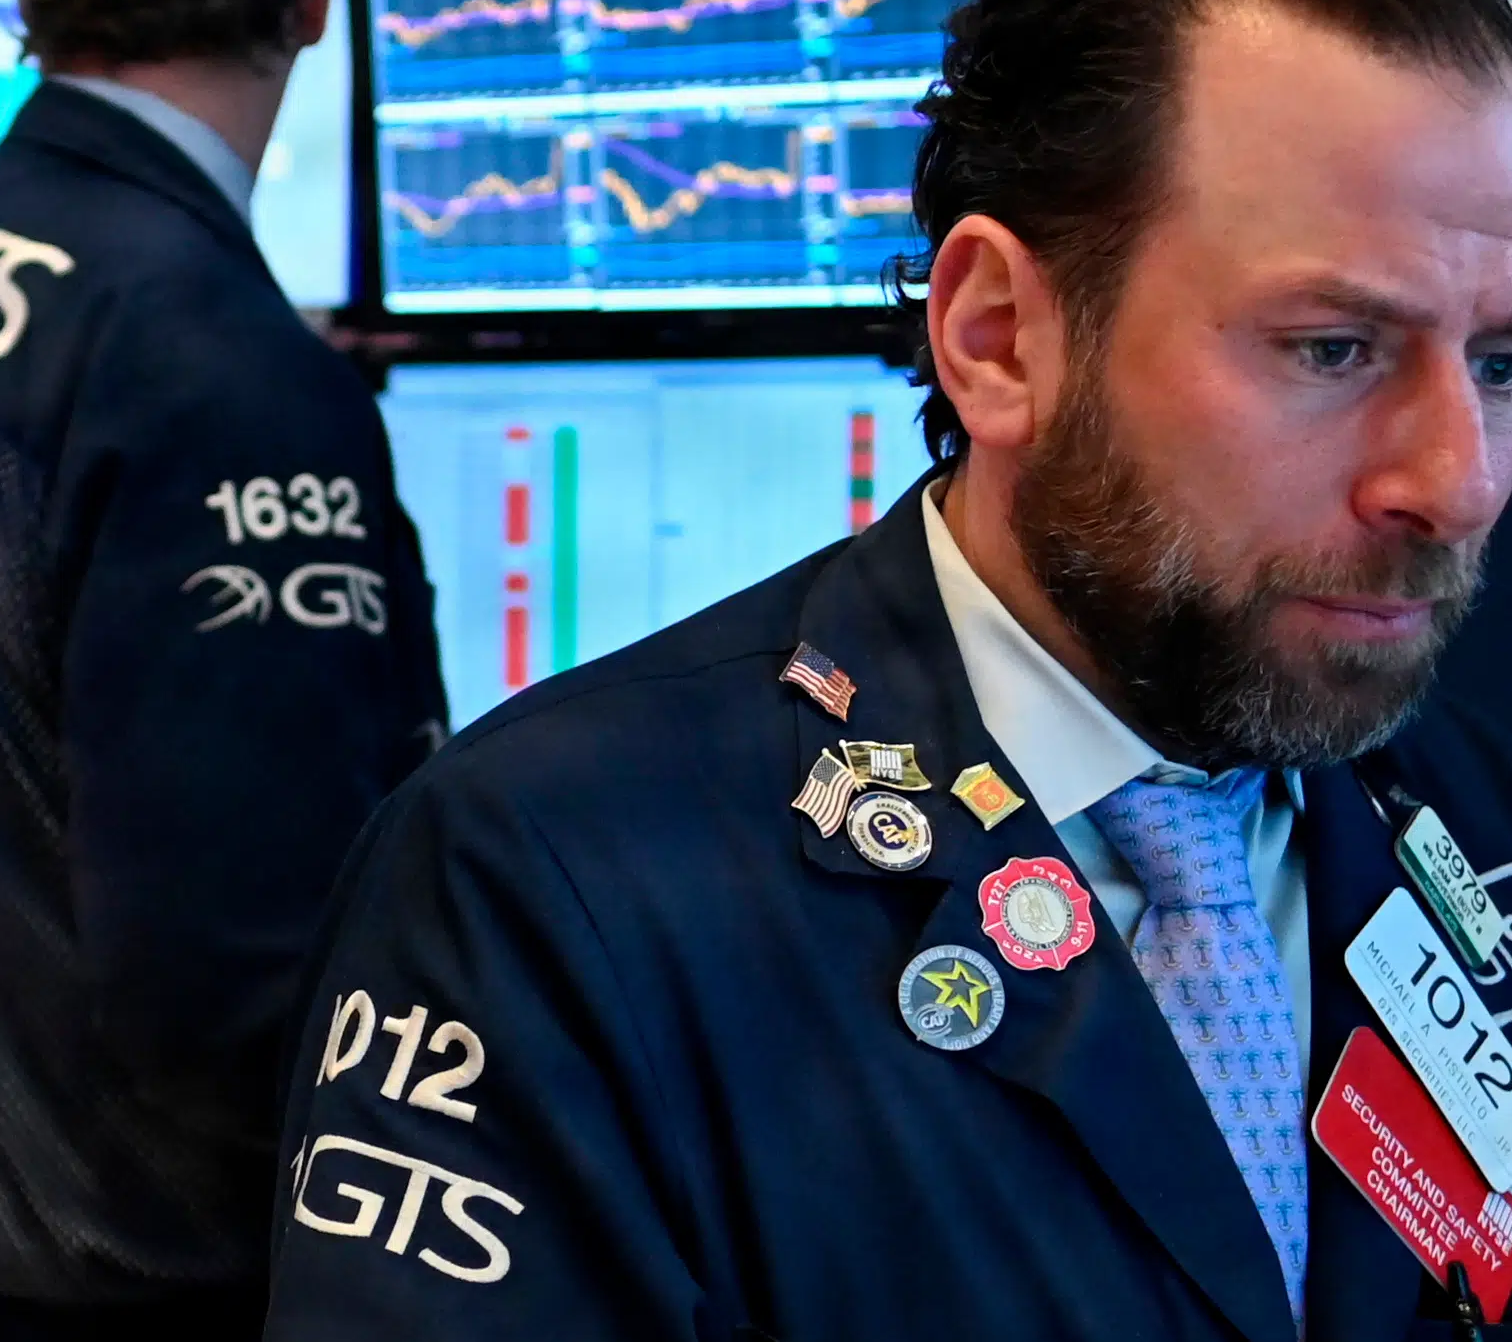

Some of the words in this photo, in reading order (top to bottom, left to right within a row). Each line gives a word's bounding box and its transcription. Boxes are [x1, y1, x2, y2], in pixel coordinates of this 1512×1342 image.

[205, 473, 367, 544] 1632
[279, 562, 388, 635] GTS
[869, 767, 904, 782] NYSE
[872, 813, 905, 845] CAF
[987, 880, 1007, 906] T2T
[1431, 831, 1491, 918] 3979
[1002, 939, 1045, 965] FDNY
[1070, 920, 1090, 947] 9-11
[963, 948, 1002, 986] HEROES
[986, 988, 1004, 1027] HEART
[1364, 938, 1419, 1017] MICHAEL
[1419, 1019, 1432, 1038] A
[293, 1132, 525, 1284] GTS
[1342, 1084, 1414, 1170] SECURITY
[1412, 1168, 1447, 1208] AND
[1445, 1204, 1502, 1272] SAFETY
[1371, 1146, 1459, 1252] COMMITTEE
[1366, 1169, 1447, 1267] CHAIRMAN
